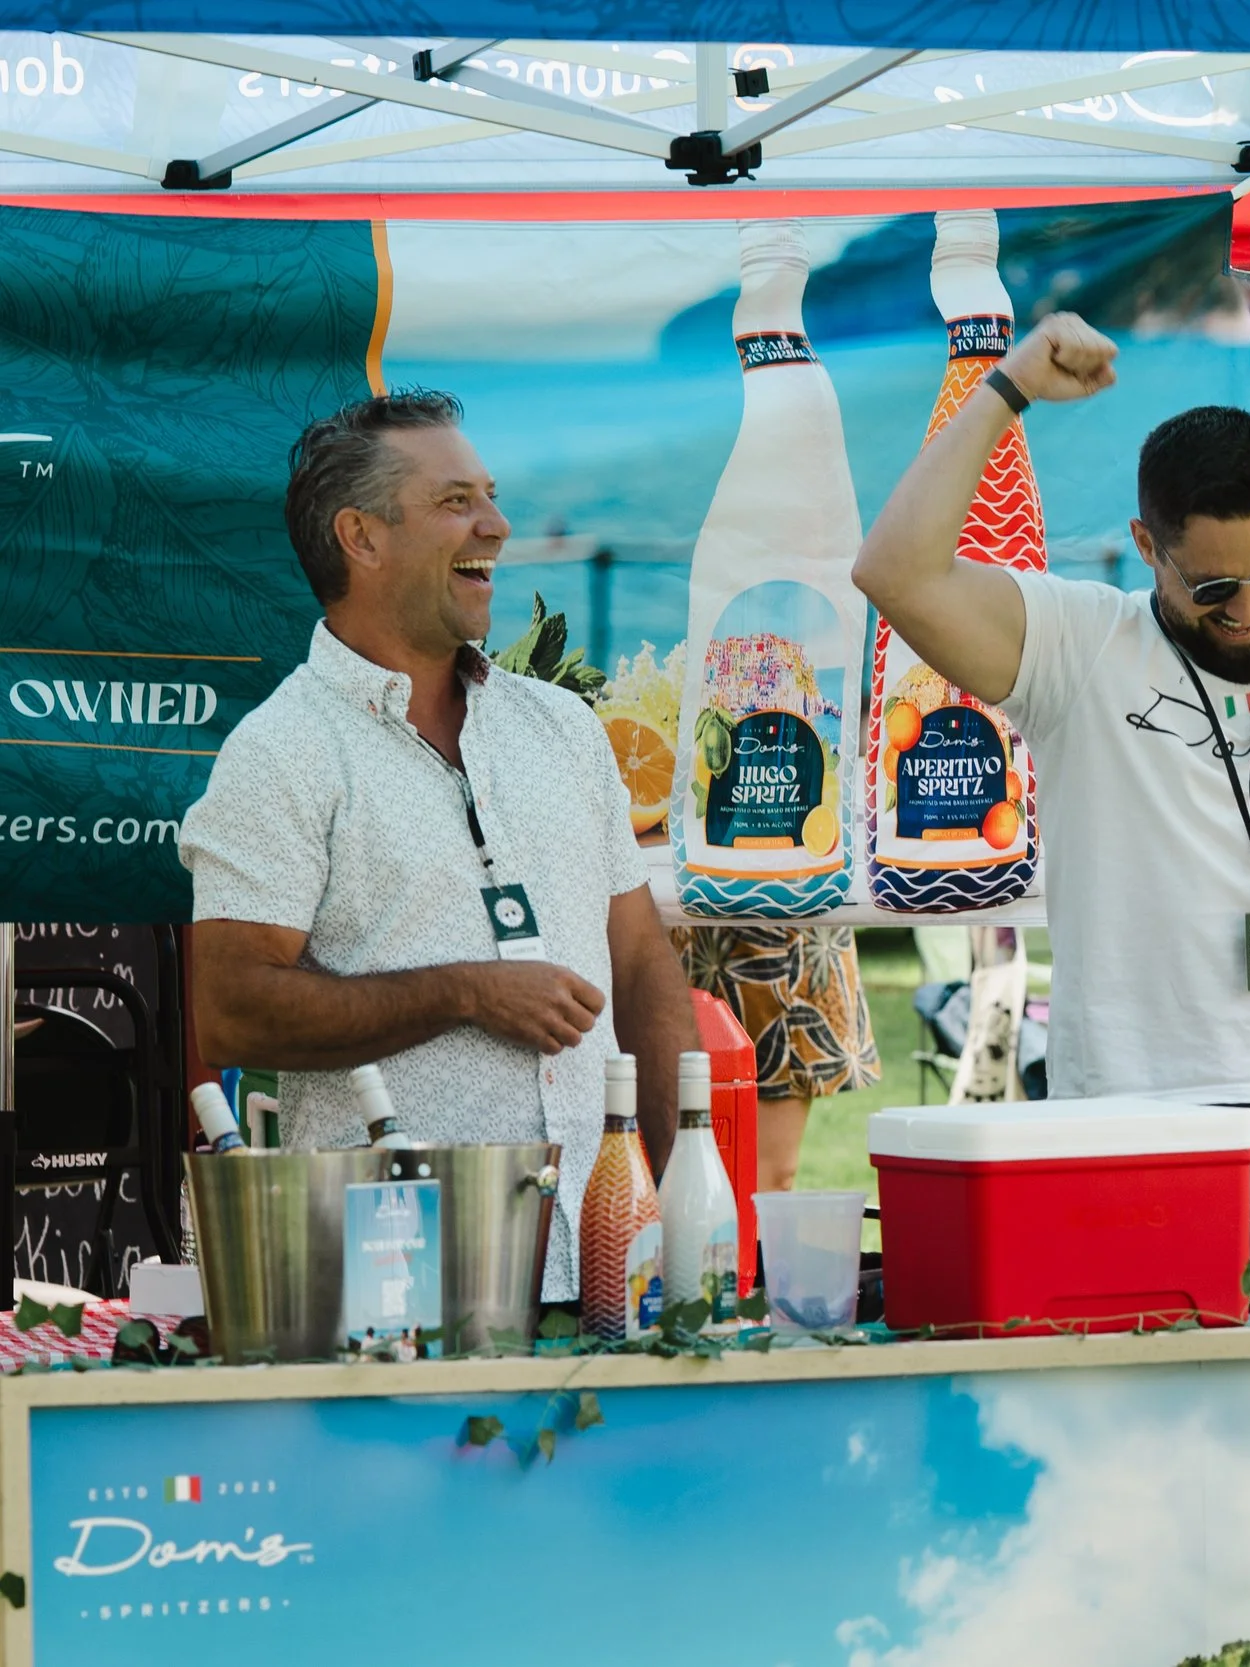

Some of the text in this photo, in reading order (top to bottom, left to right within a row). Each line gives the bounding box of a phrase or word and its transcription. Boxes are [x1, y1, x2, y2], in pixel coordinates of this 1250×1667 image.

[961, 323, 1001, 338] READY
[748, 340, 794, 354] READY
[956, 338, 974, 352] TO
[745, 352, 765, 364] TO
[19, 460, 54, 479] TM
[9, 678, 218, 726] OWNED
[733, 736, 805, 755] Dom's
[919, 730, 985, 749] Dom's
[738, 764, 798, 784] HUGO
[901, 756, 1002, 778] APERITIVO
[731, 783, 801, 804] SPRITZ
[917, 776, 985, 797] SPRITZ
[51, 1152, 108, 1169] HUSKY
[54, 1516, 313, 1577] Dom's
[99, 1596, 272, 1621] SPRITZERS
